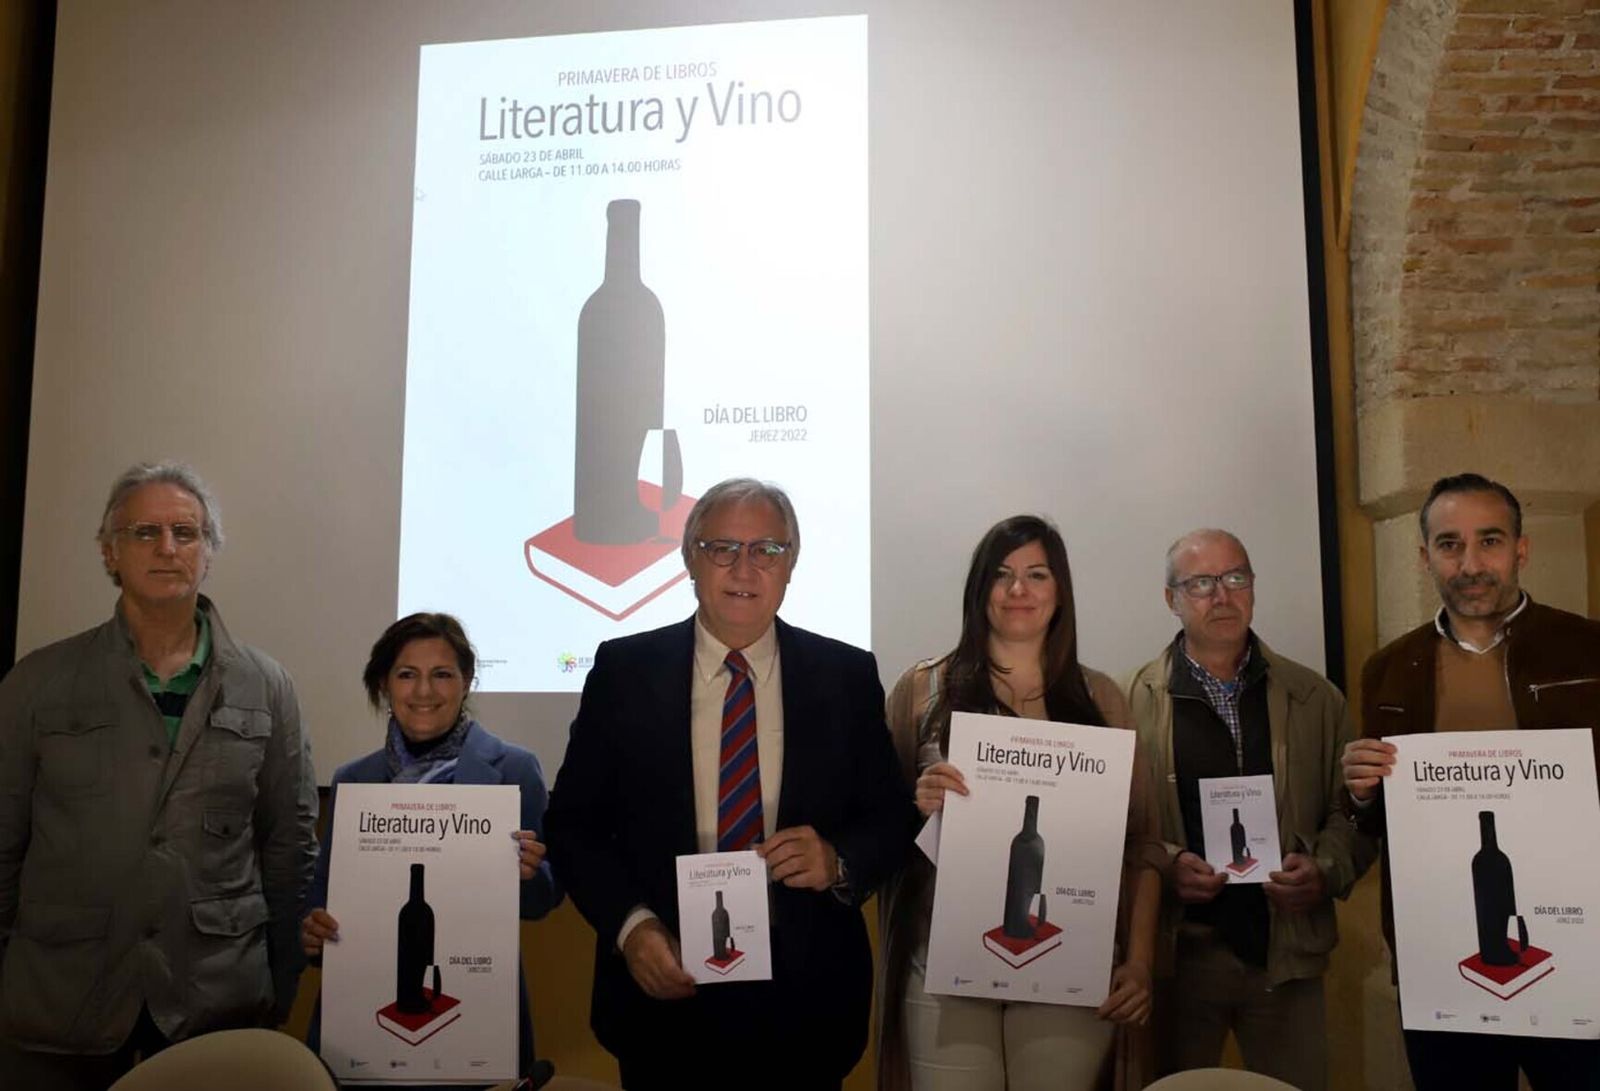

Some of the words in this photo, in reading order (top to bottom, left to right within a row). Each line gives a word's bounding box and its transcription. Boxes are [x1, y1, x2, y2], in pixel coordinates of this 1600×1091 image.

[558, 66, 640, 86] PRIMAVERA
[643, 64, 662, 81] DE
[666, 61, 718, 79] LIBROS
[479, 94, 664, 141] Literatura
[674, 96, 699, 144] y
[706, 80, 802, 126] Vino
[479, 151, 521, 165] SÁBADO
[523, 151, 537, 163] 23
[539, 150, 552, 162] DE
[555, 148, 584, 160] ABRIL
[478, 168, 508, 182] CALLE
[510, 167, 543, 180] LARGA
[553, 166, 567, 177] DE
[570, 164, 599, 176] 11.00
[601, 163, 609, 175] A
[611, 161, 641, 174] 14.00
[644, 158, 682, 173] HORAS
[703, 403, 730, 424] DÍA
[732, 406, 760, 424] DEL
[763, 405, 808, 423] LIBRO
[748, 429, 778, 443] JEREZ
[780, 428, 808, 441] 2022
[977, 741, 1052, 769] Literatura
[1055, 754, 1066, 776] y
[1069, 750, 1106, 774] Vino
[1413, 761, 1501, 782] Literatura
[1504, 764, 1516, 787] y
[1518, 758, 1565, 780] Vino
[359, 811, 435, 834] Literatura
[438, 818, 449, 841] y
[451, 813, 491, 835] Vino
[733, 866, 751, 877] Vino
